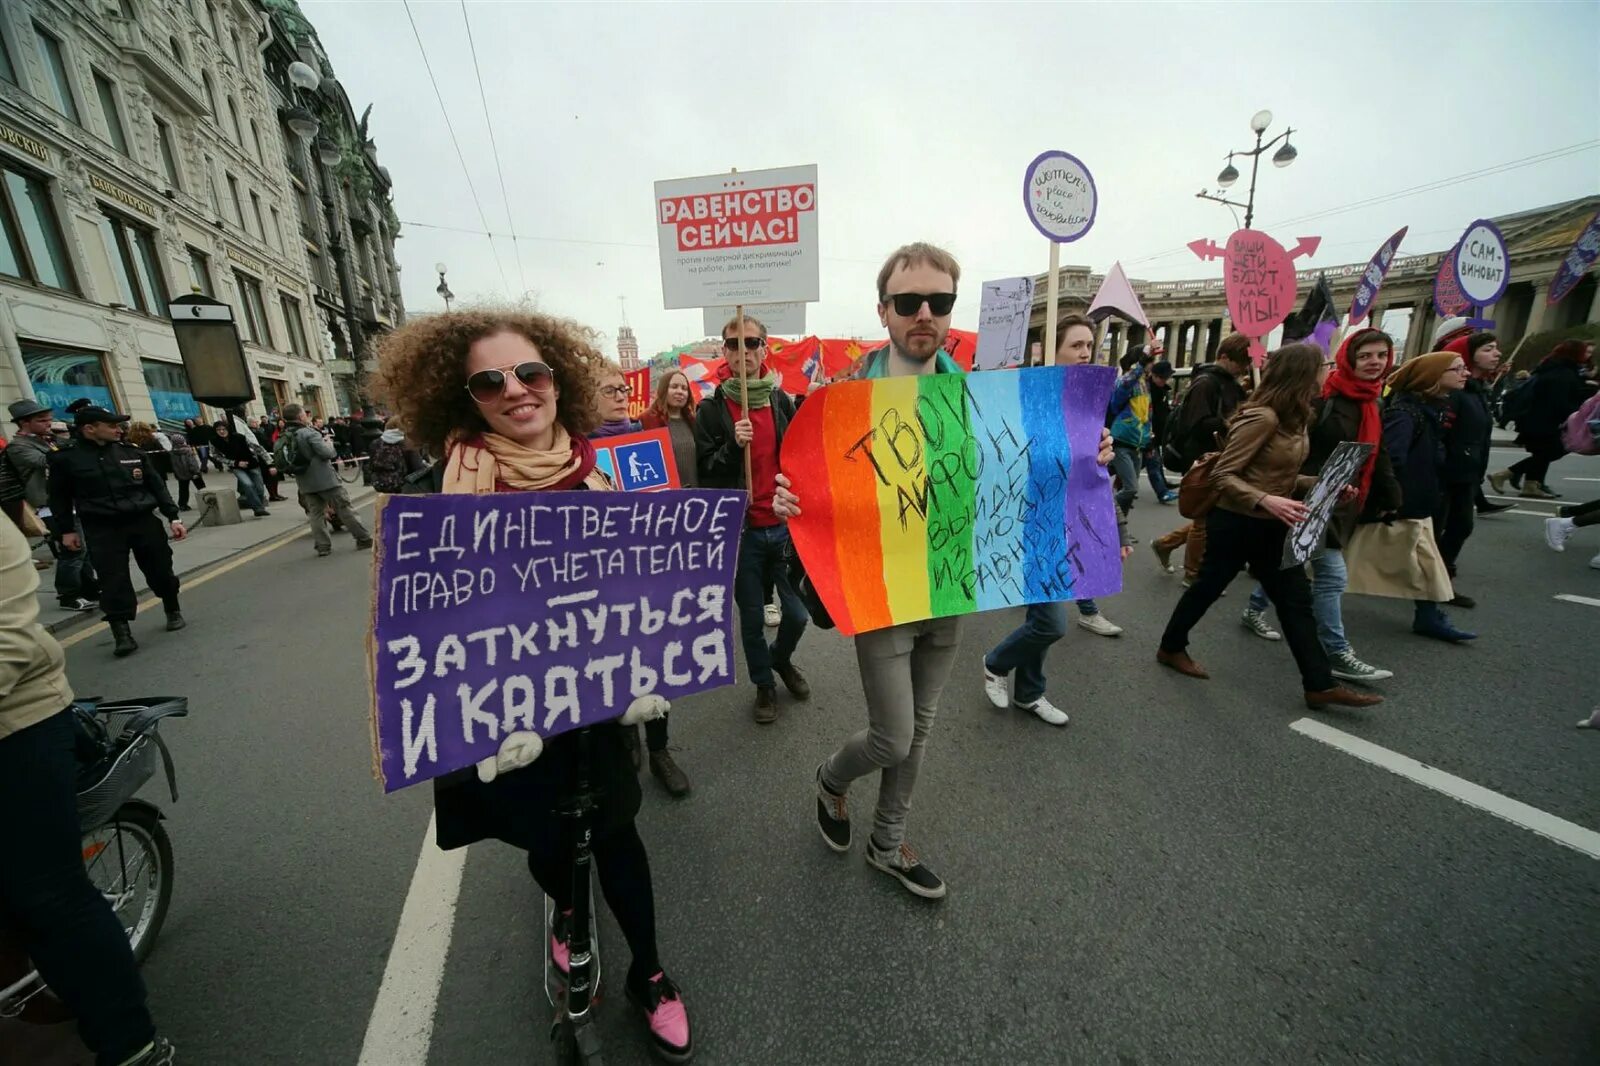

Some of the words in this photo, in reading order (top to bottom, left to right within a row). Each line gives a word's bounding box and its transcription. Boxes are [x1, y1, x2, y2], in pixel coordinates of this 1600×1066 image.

[660, 186, 814, 223] РАВЕНСТВО
[1047, 185, 1073, 200] place
[1036, 203, 1089, 225] revolution
[681, 217, 794, 248] СЕЙЧАС!
[703, 252, 741, 264] гендерной
[743, 249, 802, 262] дискриминации
[1234, 240, 1264, 254] ВАШИ
[1234, 254, 1267, 269] ДЕТИ
[1461, 261, 1504, 282] ВИНОВАТ
[1240, 288, 1269, 297] КАК
[1238, 296, 1280, 323] МЫ!
[396, 496, 740, 563] ЕДИНСТВЕННОЕ
[389, 568, 496, 617] ПРАВО
[512, 535, 726, 592] УГНЕТАТЕЛЕЙ
[933, 545, 968, 592] ИЗ
[387, 585, 726, 688] ЗАТКНУТЬСЯ
[400, 693, 438, 779] И
[457, 628, 729, 744] КАЯТЬСЯ
